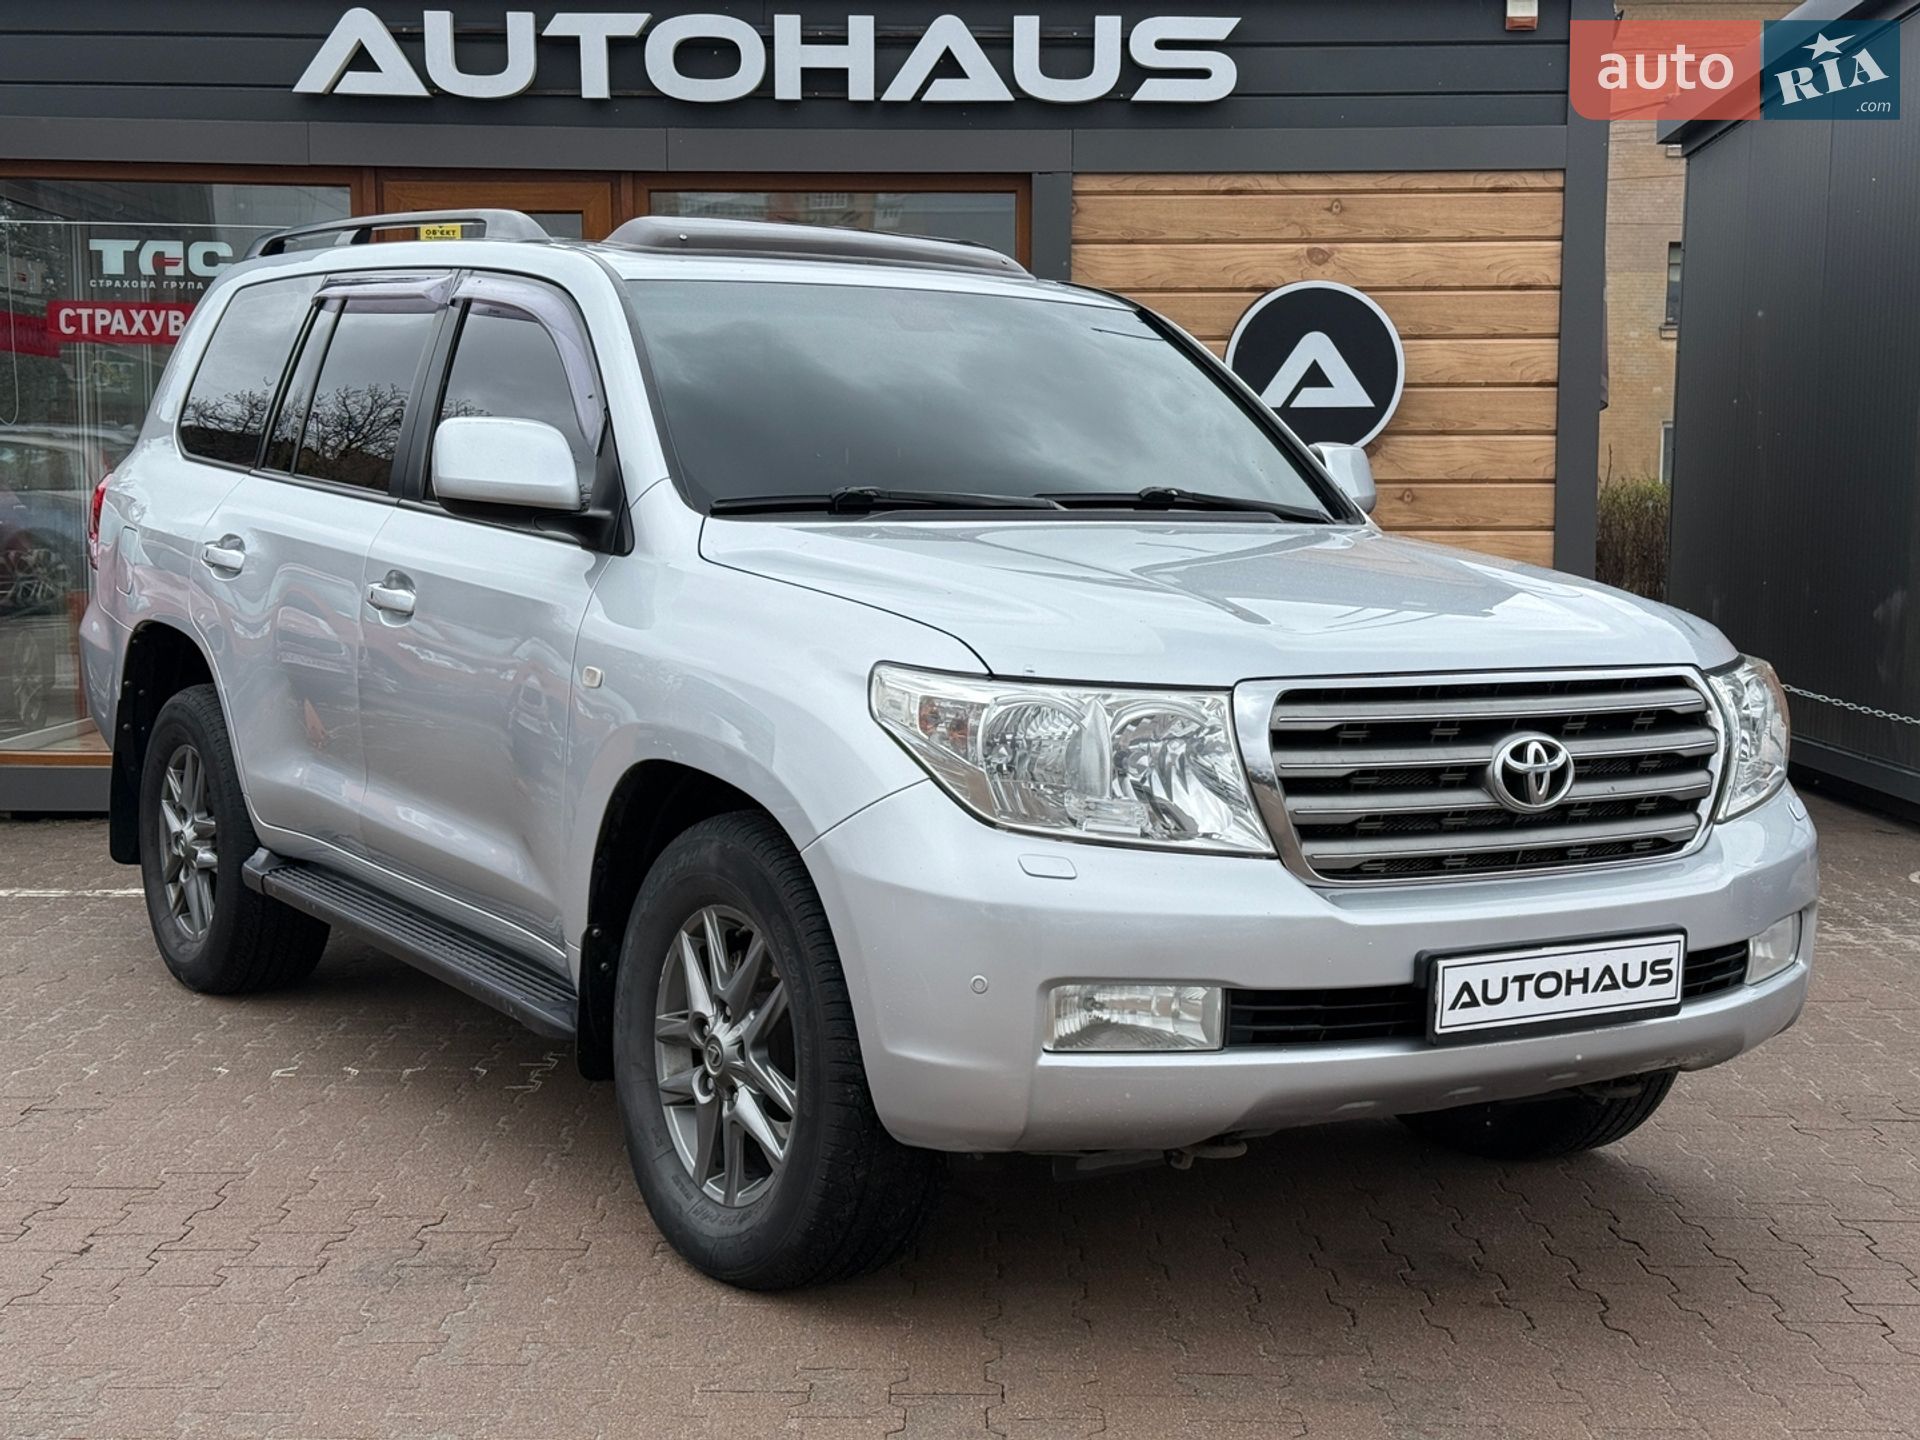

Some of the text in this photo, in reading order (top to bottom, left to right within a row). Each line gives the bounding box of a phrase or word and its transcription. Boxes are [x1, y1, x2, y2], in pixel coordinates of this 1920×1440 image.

[292, 7, 1242, 103] AUTOHAUS
[89, 278, 204, 291] СТРАХОВА ГРУПА
[1259, 330, 1376, 408] A
[1448, 958, 1673, 1010] AUTOHAUS
